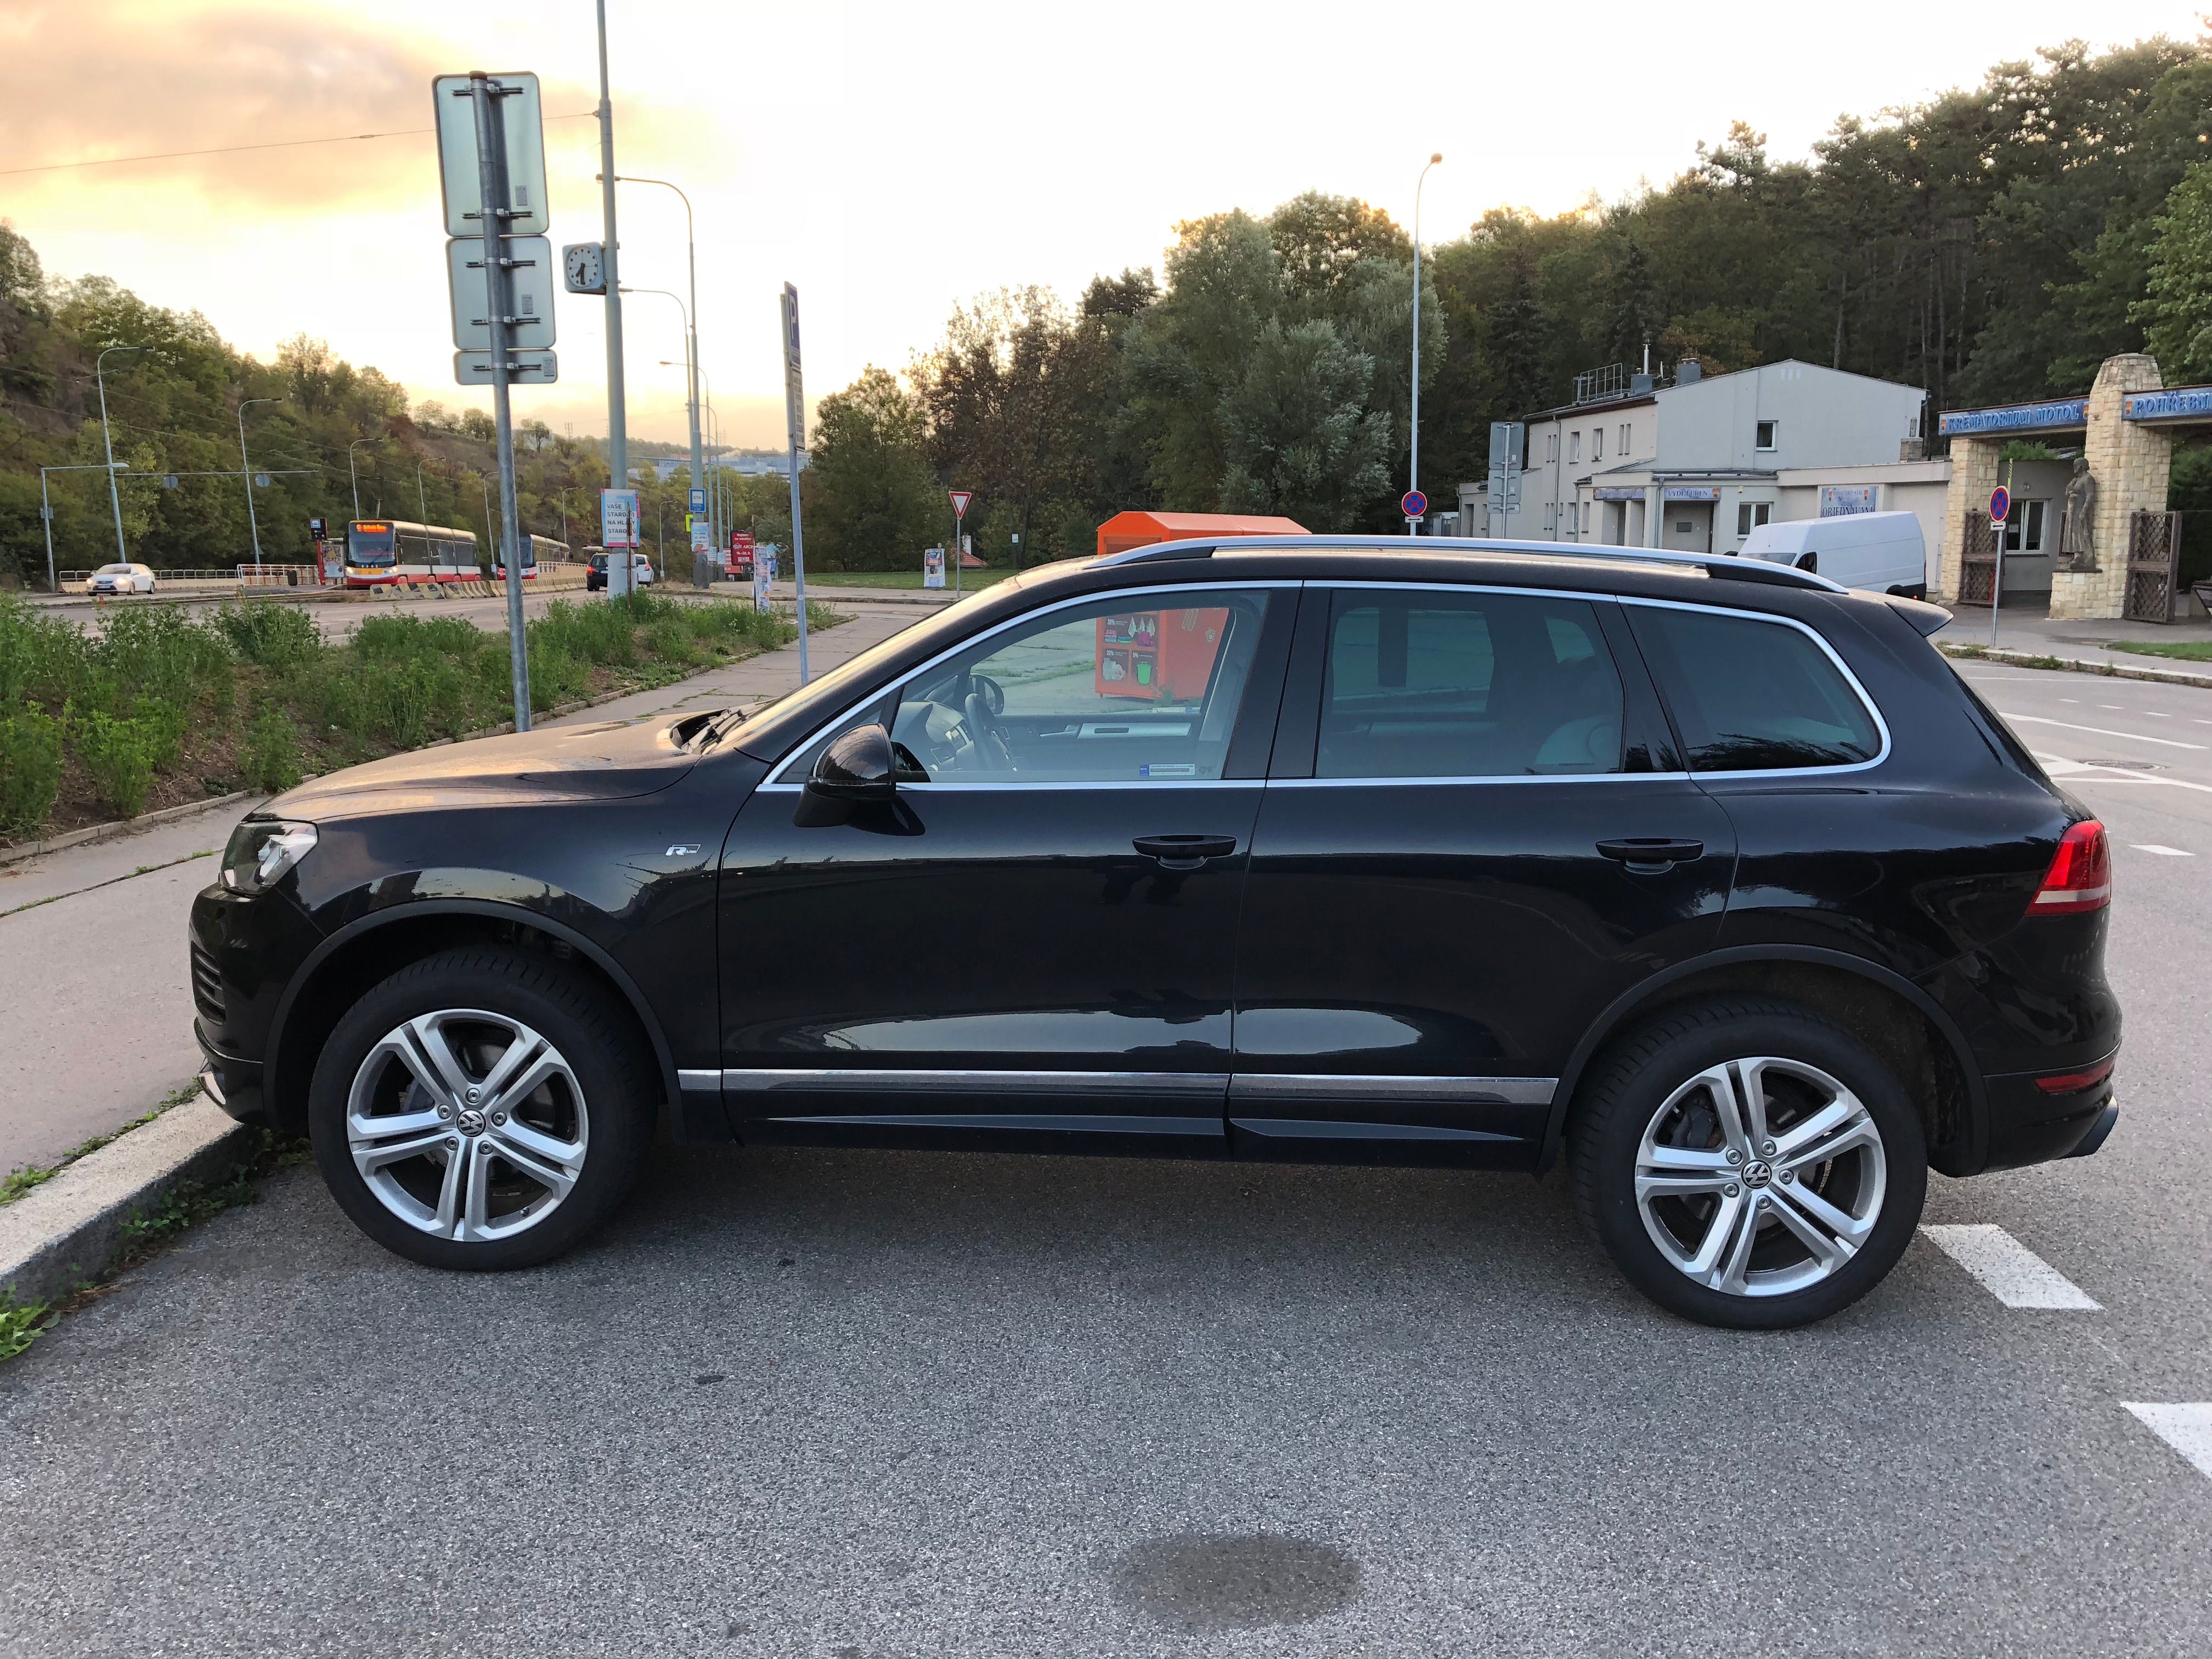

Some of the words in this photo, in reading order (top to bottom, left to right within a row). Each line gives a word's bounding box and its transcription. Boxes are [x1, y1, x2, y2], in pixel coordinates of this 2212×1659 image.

[789, 294, 796, 339] P
[2136, 391, 2212, 413] POHŘEBN
[1948, 409, 2030, 430] KREMATORIUM
[2036, 404, 2079, 422] MOTOL
